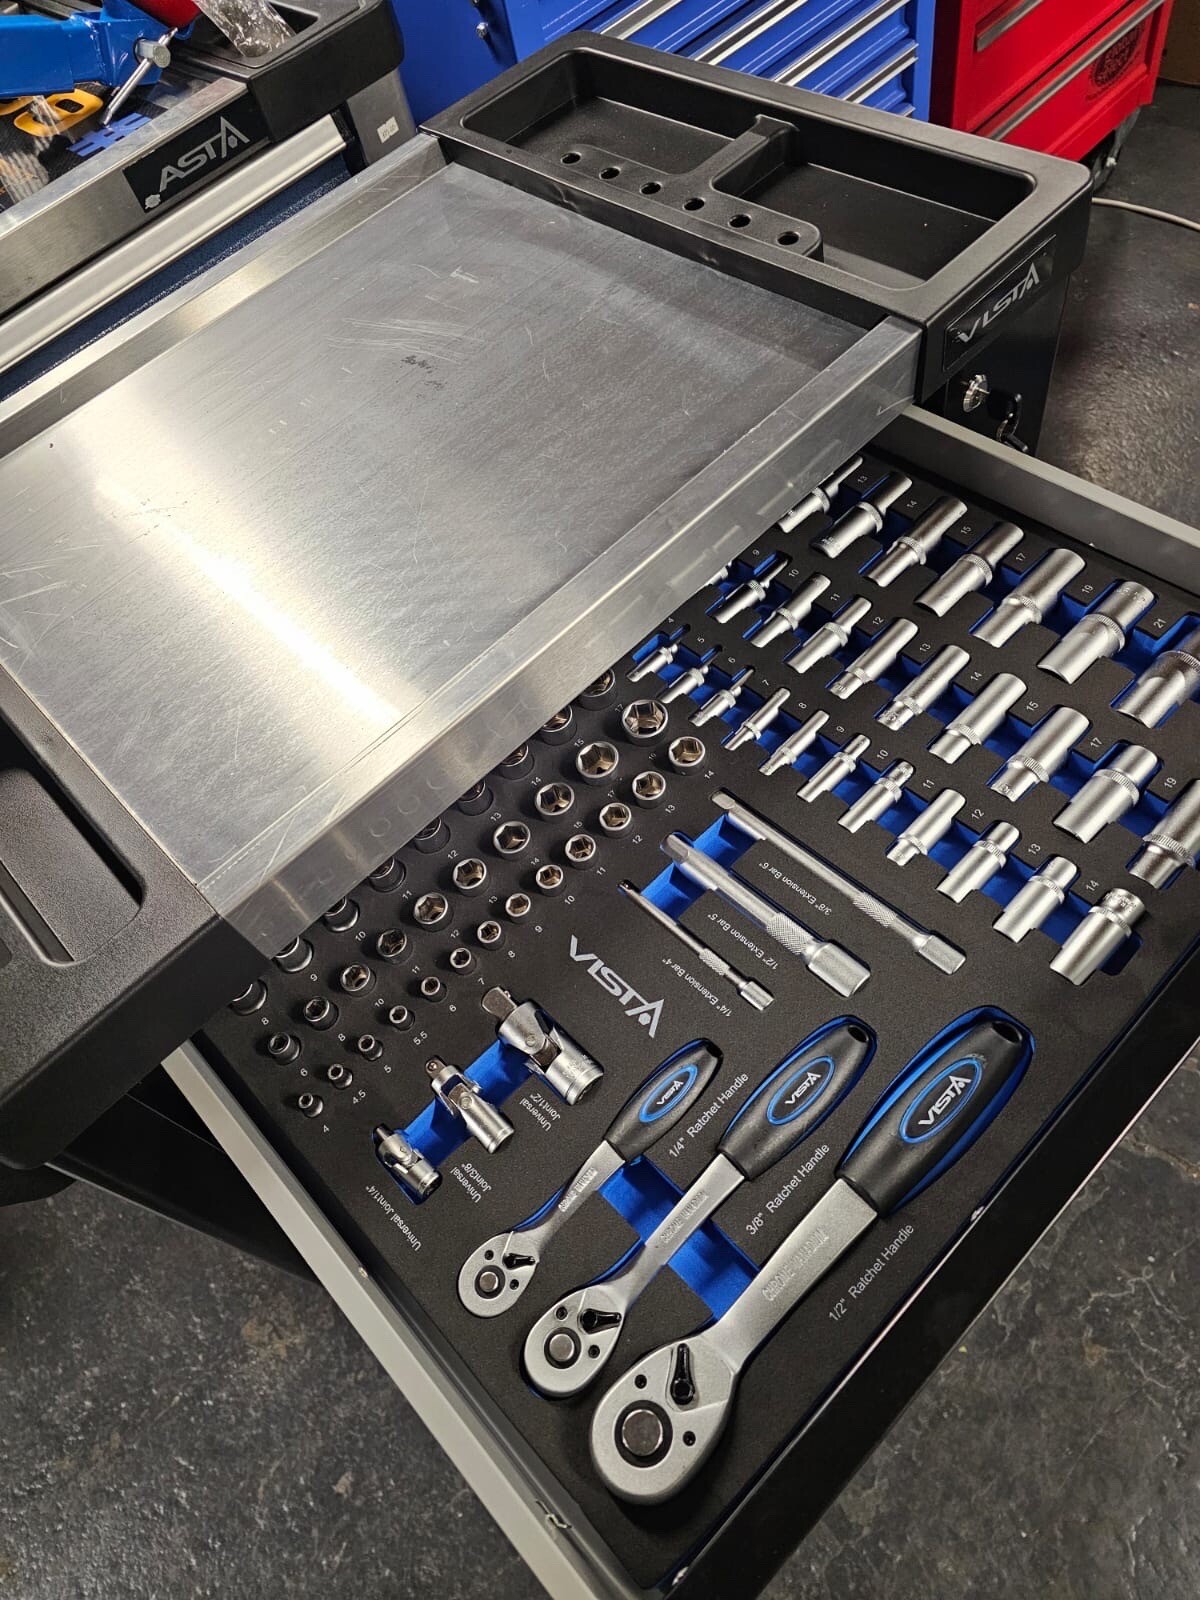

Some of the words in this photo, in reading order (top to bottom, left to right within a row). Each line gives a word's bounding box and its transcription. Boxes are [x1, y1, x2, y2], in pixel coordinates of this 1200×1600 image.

[159, 116, 251, 193] ASTA
[857, 475, 868, 485] 13
[906, 500, 918, 509] 14
[960, 526, 972, 536] 15
[752, 548, 760, 557] 9
[1015, 552, 1026, 562] 17
[788, 568, 800, 577] 10
[1081, 584, 1094, 594] 19
[830, 593, 841, 601] 11
[872, 616, 884, 625] 12
[1153, 618, 1167, 629] 21
[696, 636, 705, 644] 5
[919, 643, 931, 652] 13
[727, 656, 736, 664] 6
[970, 671, 983, 681] 14
[1026, 700, 1039, 711] 15
[836, 725, 845, 733] 9
[573, 738, 585, 747] 15
[1090, 737, 1102, 748] 17
[876, 749, 889, 760] 10
[704, 770, 715, 779] 14
[531, 776, 542, 786] 14
[922, 779, 935, 789] 11
[1163, 777, 1177, 788] 19
[664, 804, 676, 814] 13
[971, 808, 985, 820] 12
[490, 812, 502, 822] 13
[632, 834, 643, 844] 12
[1027, 843, 1041, 855] 13
[447, 849, 459, 860] 12
[530, 857, 540, 865] 14
[596, 866, 606, 875] 11
[768, 867, 782, 879] Bar
[782, 876, 817, 904] Extension
[1085, 880, 1099, 891] 14
[402, 889, 413, 899] 11
[488, 895, 498, 904] 13
[564, 895, 575, 905] 10
[534, 925, 543, 933] 9
[717, 919, 731, 931] Bar
[355, 931, 366, 941] 10
[450, 929, 460, 939] 12
[730, 928, 764, 958] Extension
[507, 950, 516, 958] 8
[411, 965, 420, 974] 11
[671, 964, 686, 977] Bar
[310, 973, 318, 982] 9
[477, 977, 485, 985] 7
[684, 973, 719, 1005] Extension
[374, 998, 385, 1007] 10
[449, 1004, 457, 1012] 6
[261, 1017, 270, 1026] 8
[337, 1033, 346, 1042] 8
[413, 1030, 428, 1046] 5.5
[300, 1067, 308, 1077] 6
[383, 1064, 392, 1074] 5
[352, 1089, 366, 1104] 4.5
[687, 1102, 721, 1138] Ratchet
[717, 1073, 748, 1105] Handle
[519, 1098, 551, 1131] Universal
[322, 1124, 330, 1133] 4
[766, 1178, 801, 1213] Ratchet
[798, 1144, 829, 1180] Handle
[450, 1167, 481, 1203] Universal
[390, 1213, 421, 1251] Universal
[848, 1259, 885, 1299] Ratchet
[881, 1224, 914, 1260] Handle
